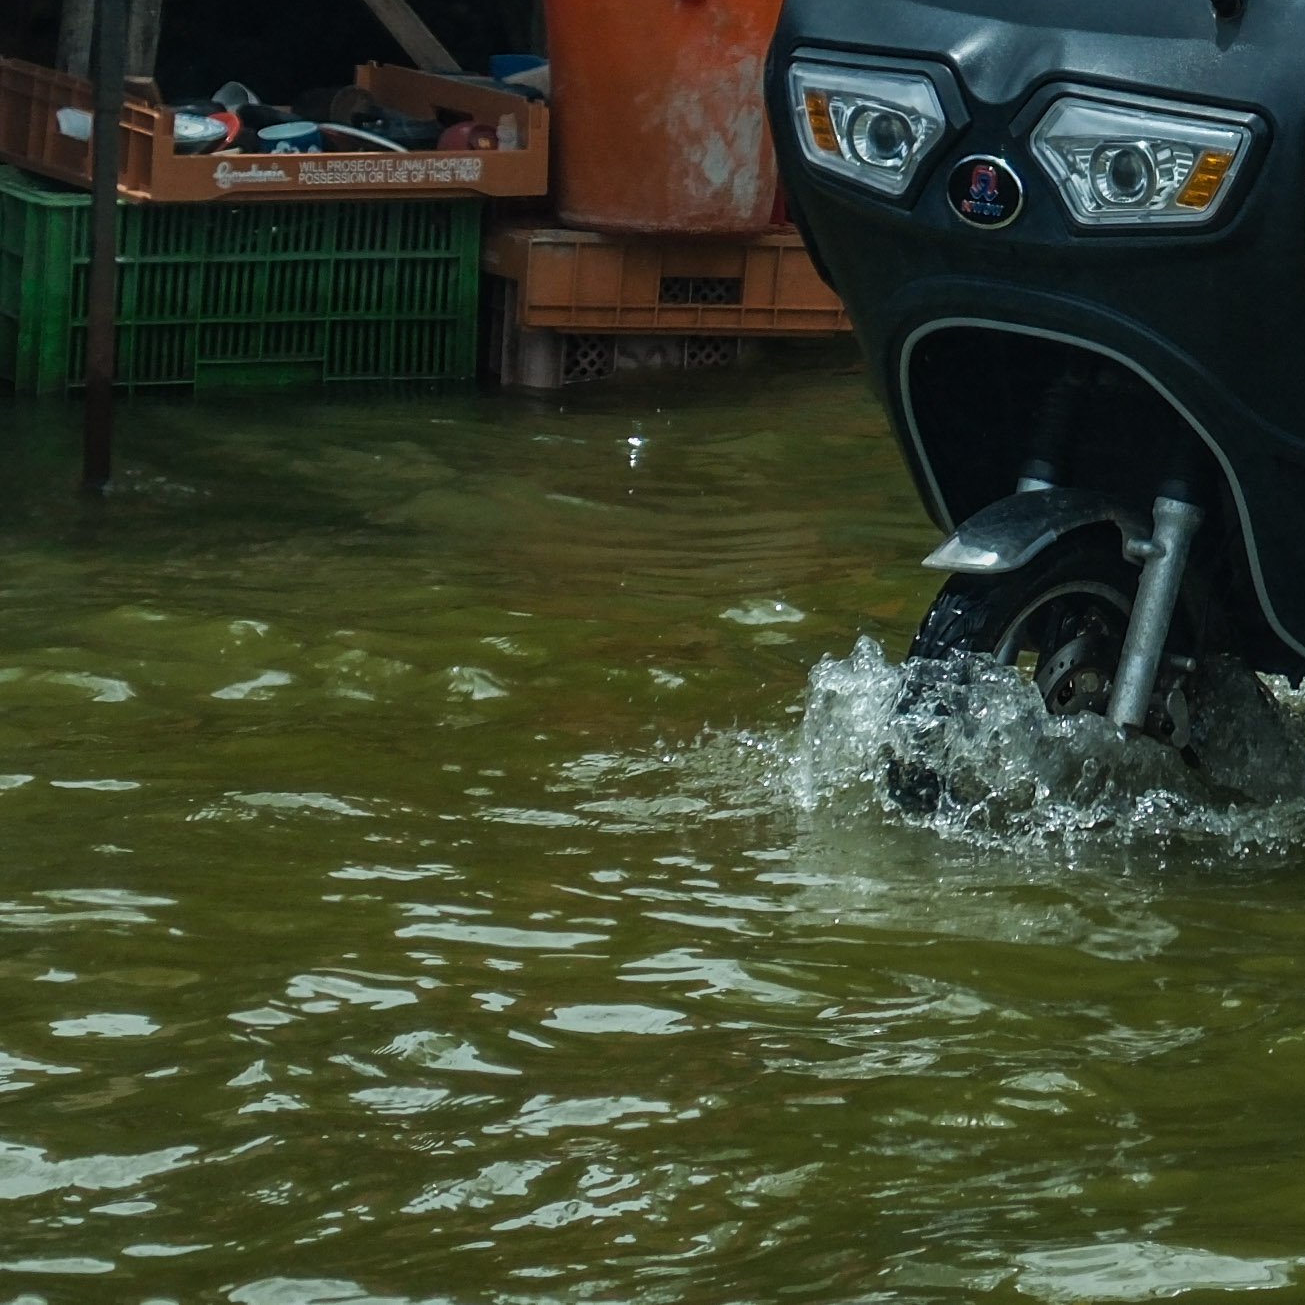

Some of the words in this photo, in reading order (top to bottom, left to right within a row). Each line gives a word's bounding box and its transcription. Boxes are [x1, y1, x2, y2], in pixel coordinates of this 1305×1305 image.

[299, 161, 325, 173] WILL
[327, 159, 393, 172] PROSECUTE
[395, 158, 481, 170] UNAUTHORIZED
[299, 172, 366, 184] POSSESSION
[368, 171, 385, 183] OR
[387, 171, 408, 183] USE
[411, 171, 425, 182] OF
[426, 170, 451, 182] THIS
